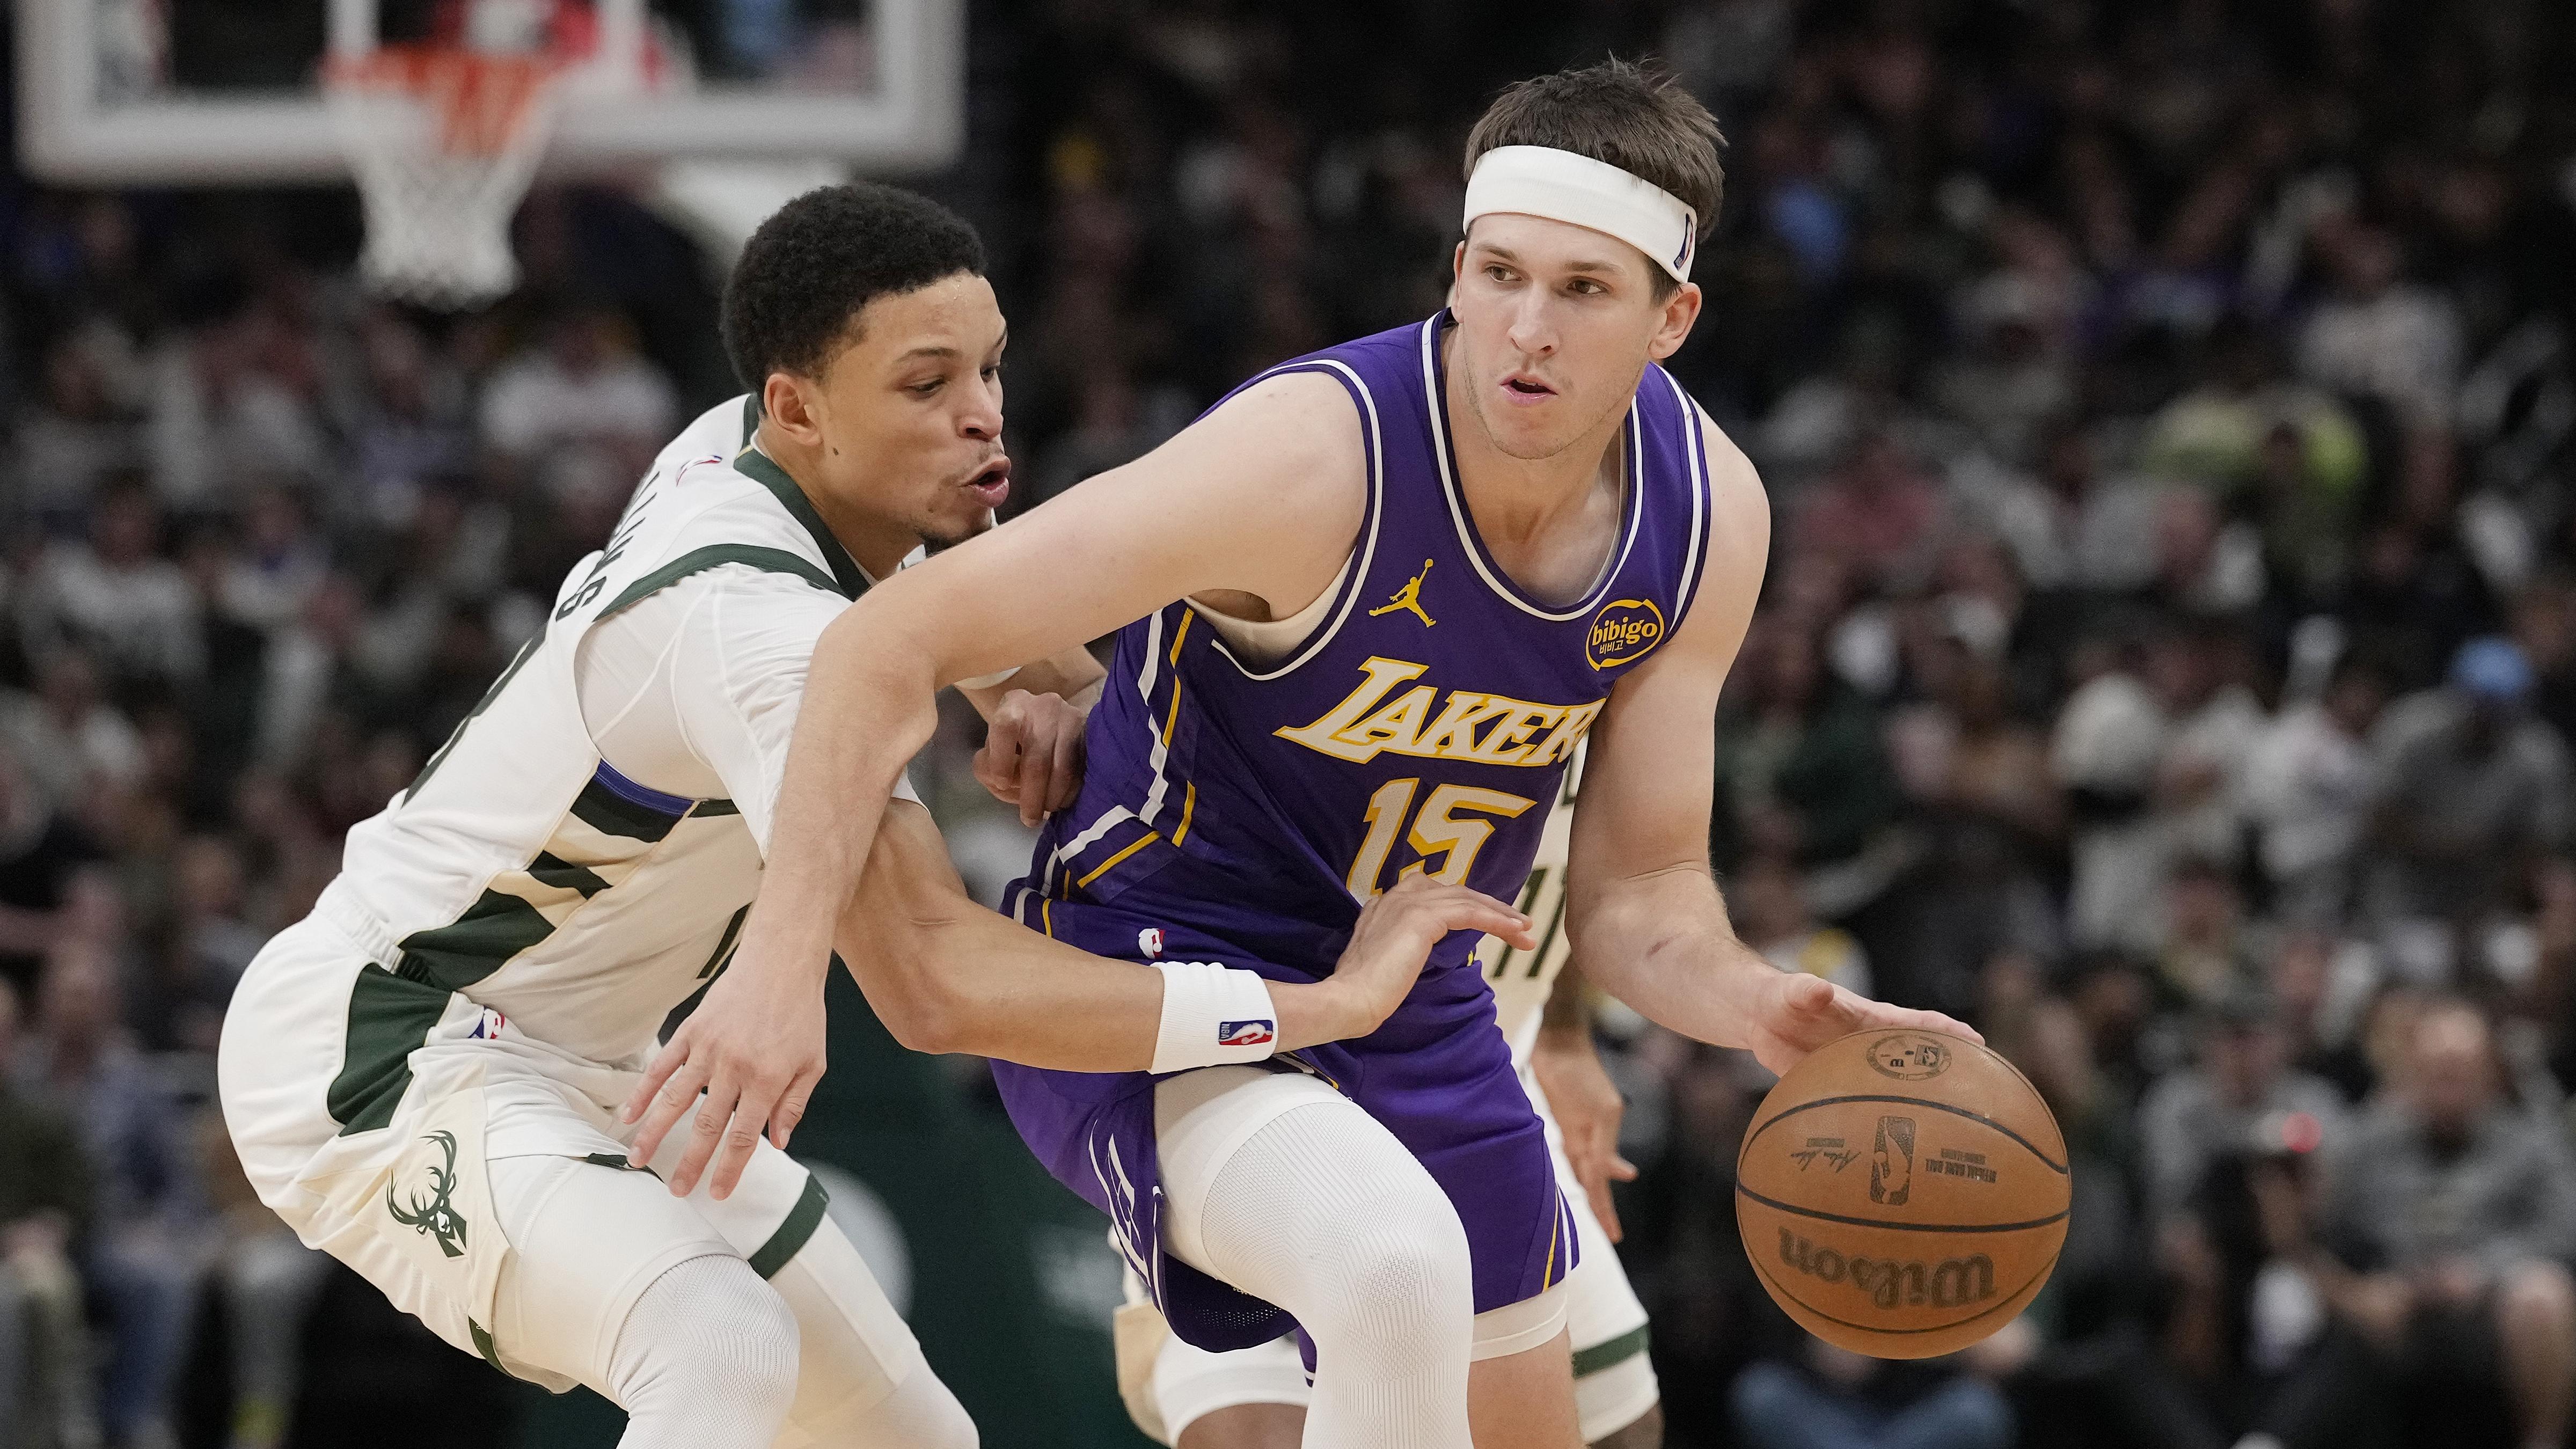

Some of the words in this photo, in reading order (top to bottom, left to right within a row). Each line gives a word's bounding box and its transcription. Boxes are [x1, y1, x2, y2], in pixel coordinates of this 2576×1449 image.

[1592, 616, 1658, 646] bibigo
[1599, 639, 1624, 655] 비비고
[1273, 656, 1607, 765] LAKER
[1346, 777, 1538, 908] 15
[1220, 1023, 1230, 1039] NBA
[1778, 1226, 1997, 1310] Wilson
